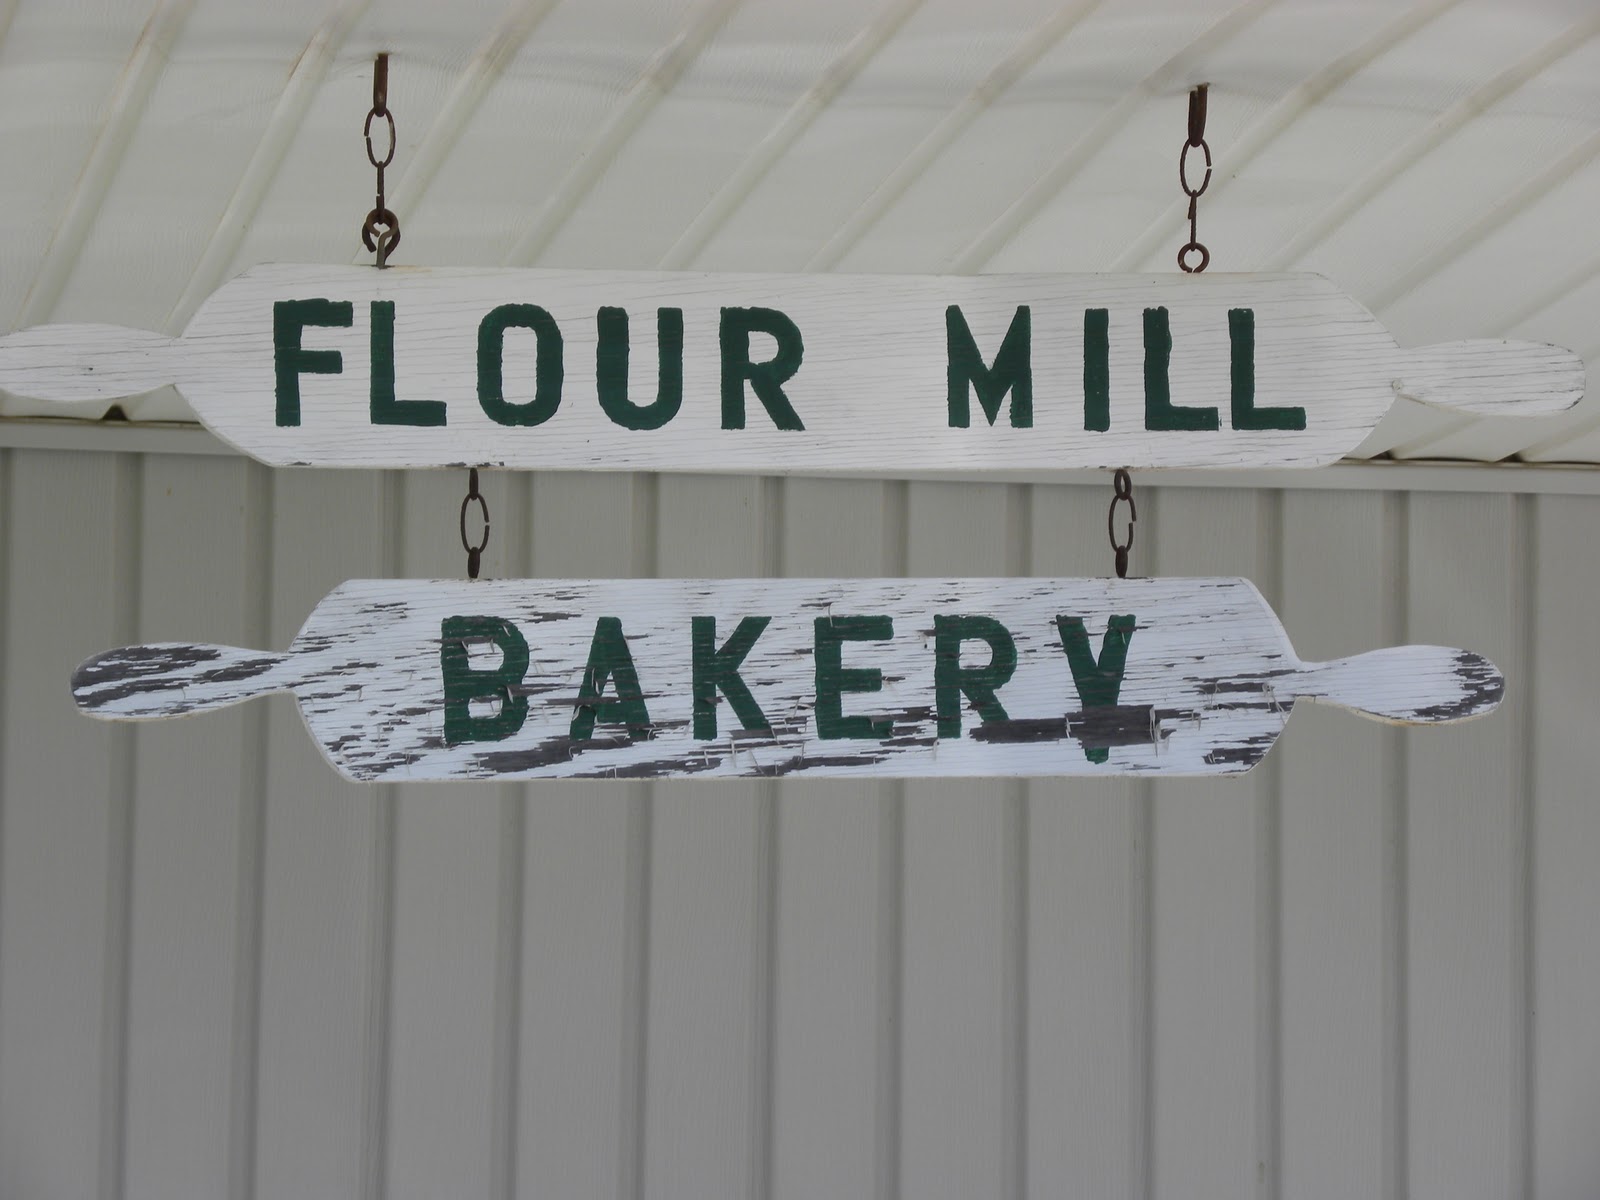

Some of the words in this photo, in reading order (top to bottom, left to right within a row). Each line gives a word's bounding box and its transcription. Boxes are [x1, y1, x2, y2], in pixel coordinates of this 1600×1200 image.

[272, 298, 806, 431] FLOUR
[946, 304, 1306, 432] MILL
[440, 613, 1136, 763] BAKERY
